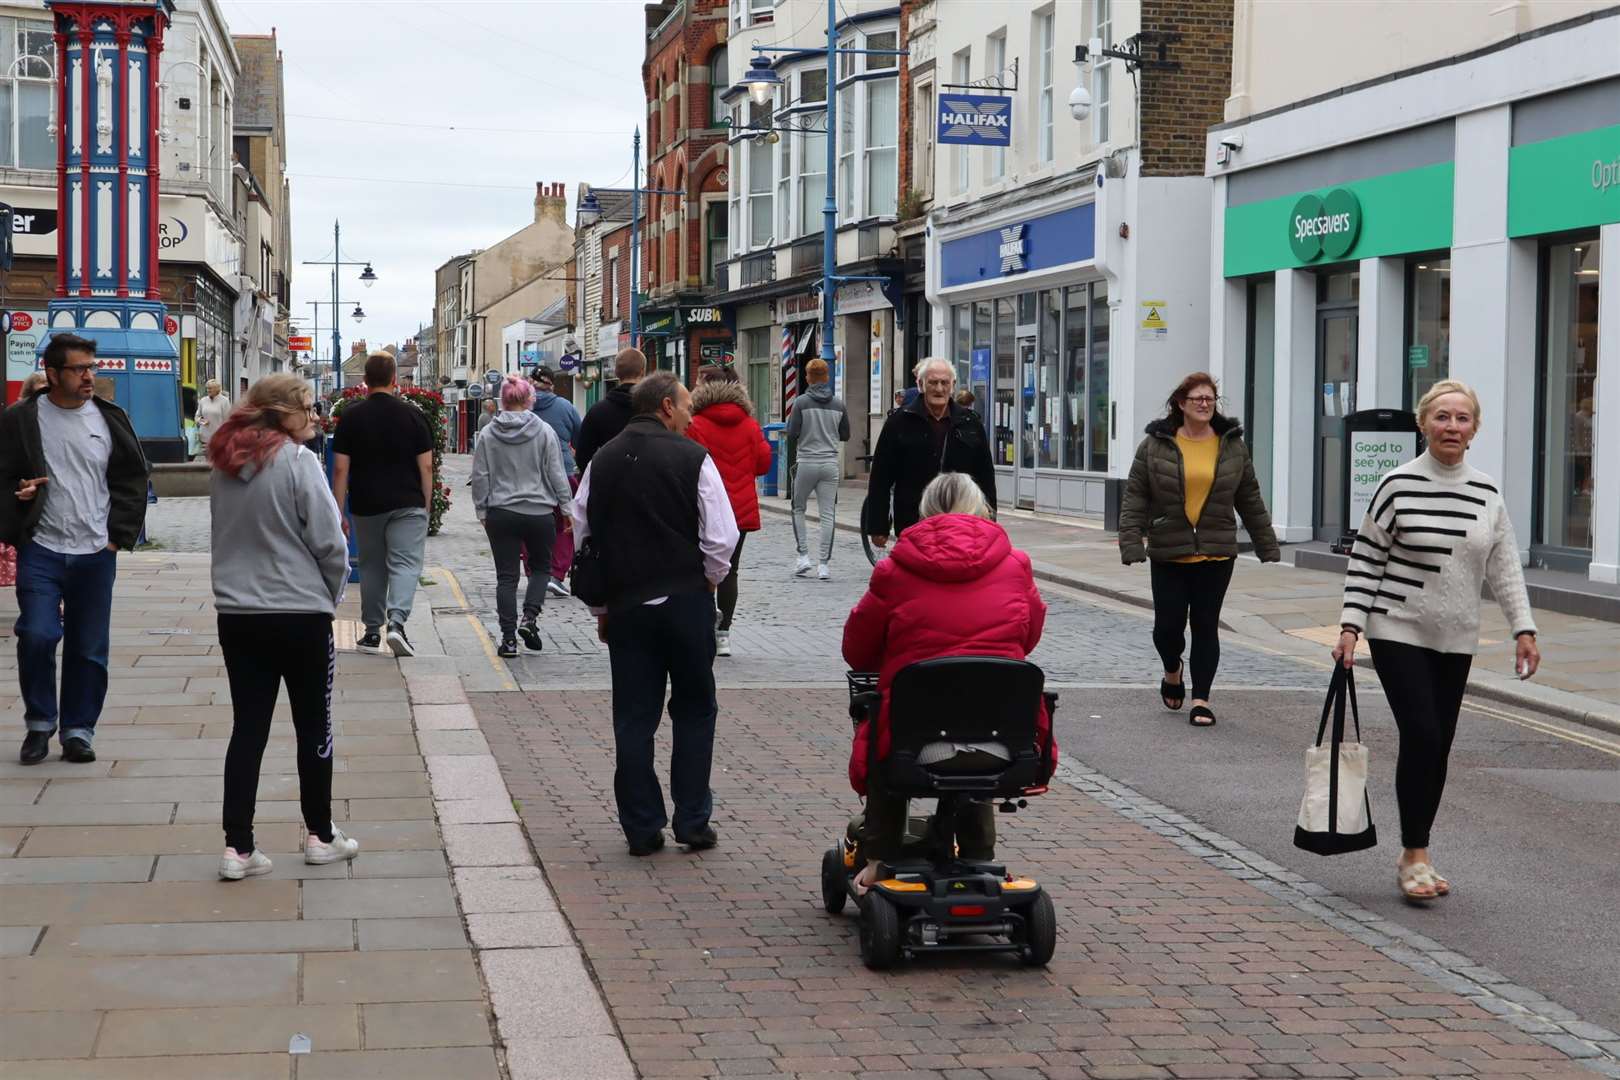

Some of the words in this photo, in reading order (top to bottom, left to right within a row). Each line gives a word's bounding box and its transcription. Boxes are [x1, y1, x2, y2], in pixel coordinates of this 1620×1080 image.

[941, 113, 1008, 127] HALIFAX
[1295, 212, 1350, 243] Specsavers
[644, 316, 672, 333] SUBWAY
[10, 340, 35, 349] Paying
[1354, 441, 1386, 453] Good
[1390, 443, 1403, 453] to
[1354, 458, 1375, 468] see
[1377, 459, 1399, 469] you
